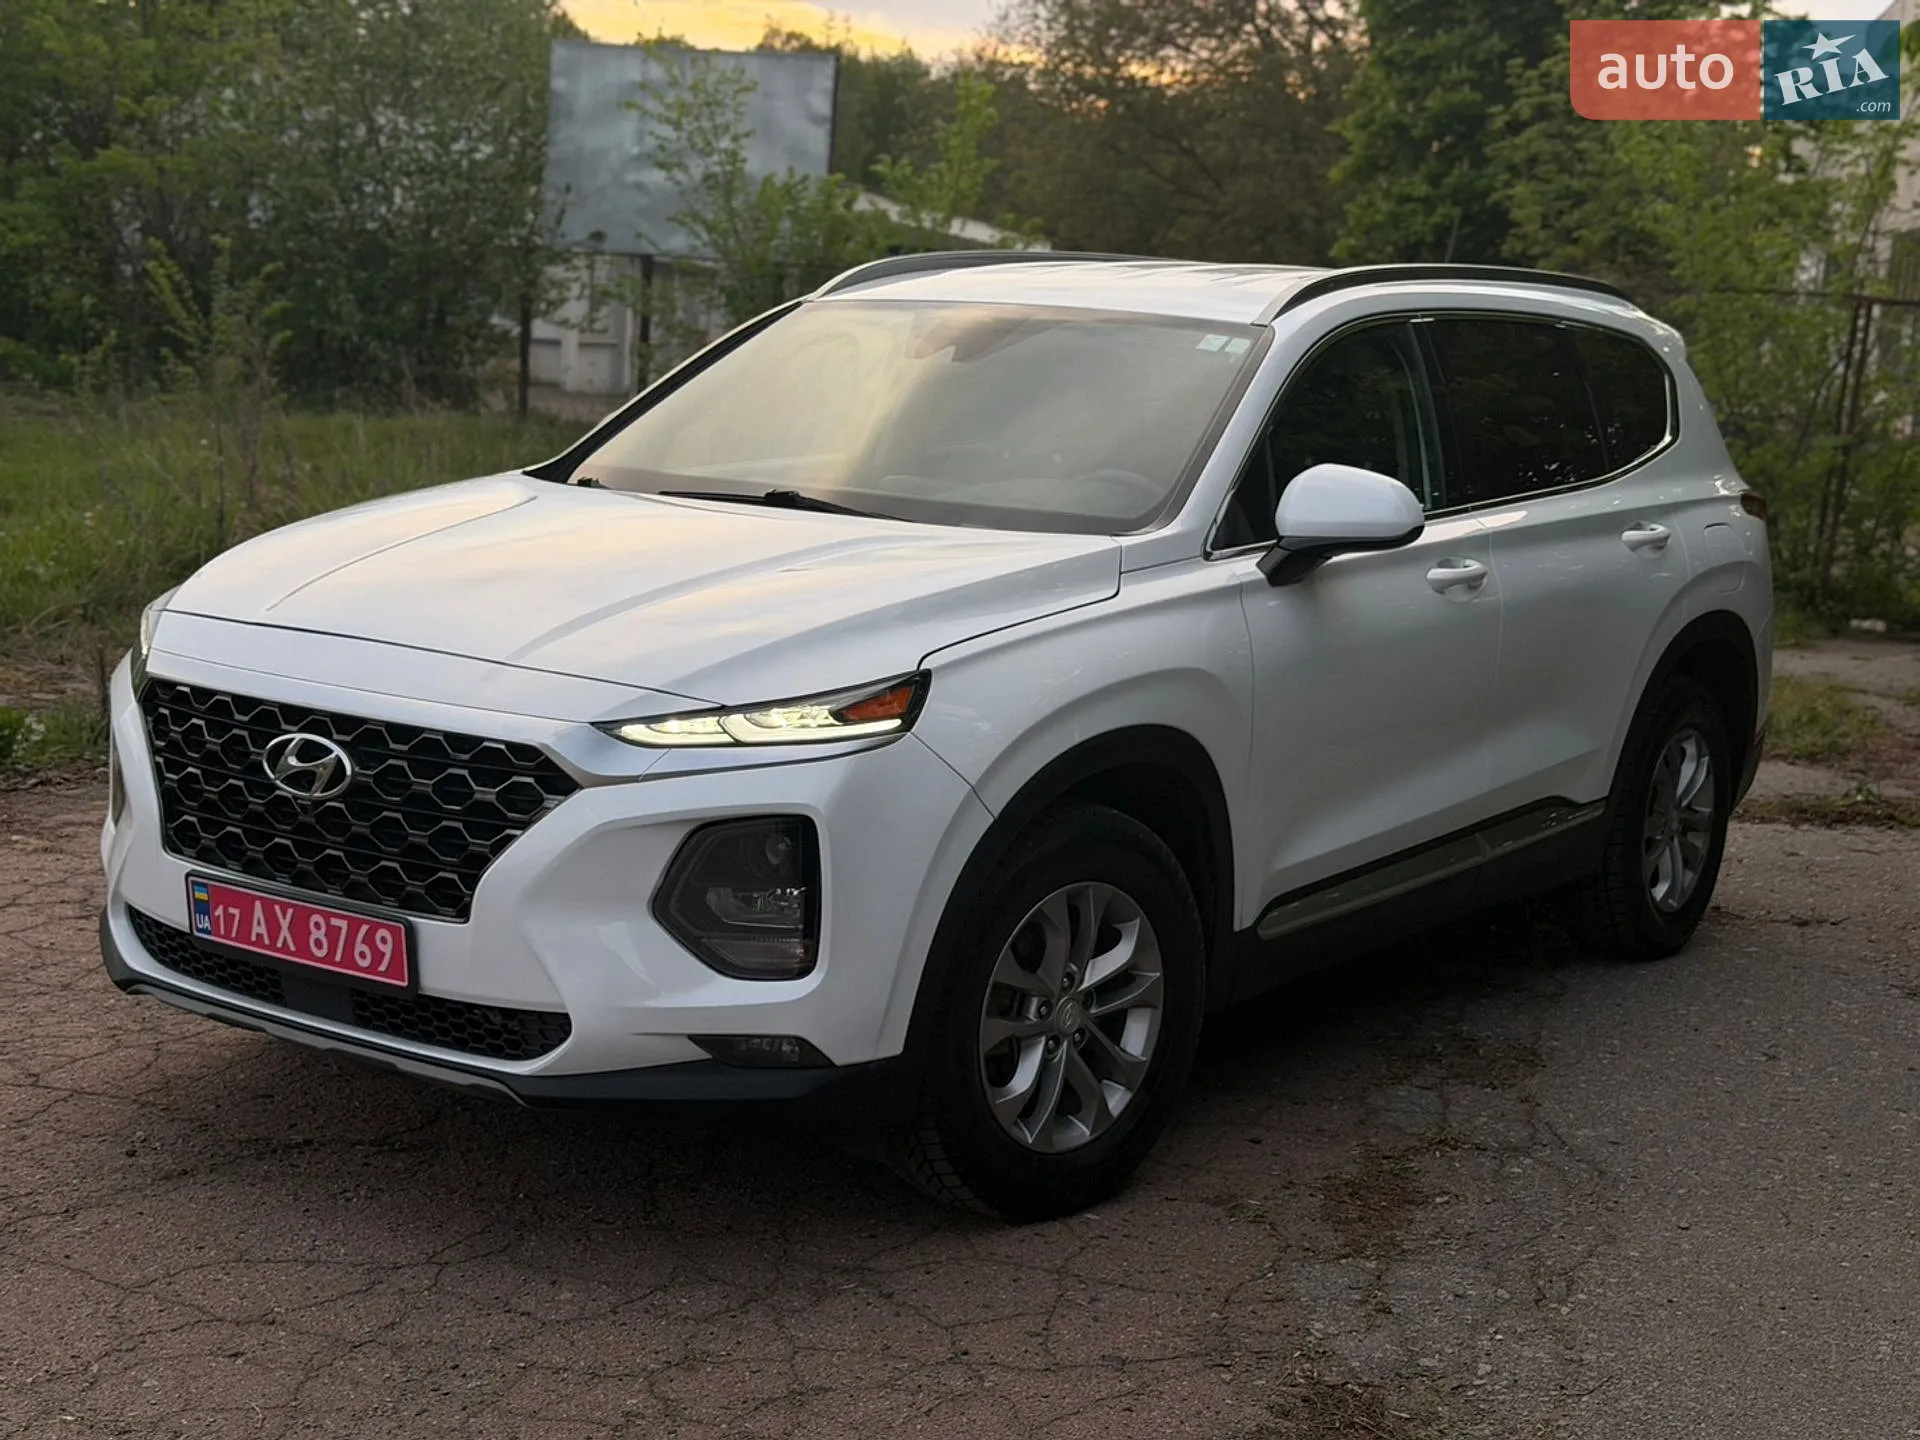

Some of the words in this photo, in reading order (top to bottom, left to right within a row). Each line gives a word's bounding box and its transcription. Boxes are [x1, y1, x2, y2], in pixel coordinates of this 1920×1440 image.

[196, 913, 212, 930] UA
[214, 904, 240, 938] 17
[251, 900, 296, 951] AX
[309, 913, 394, 972] 8769
